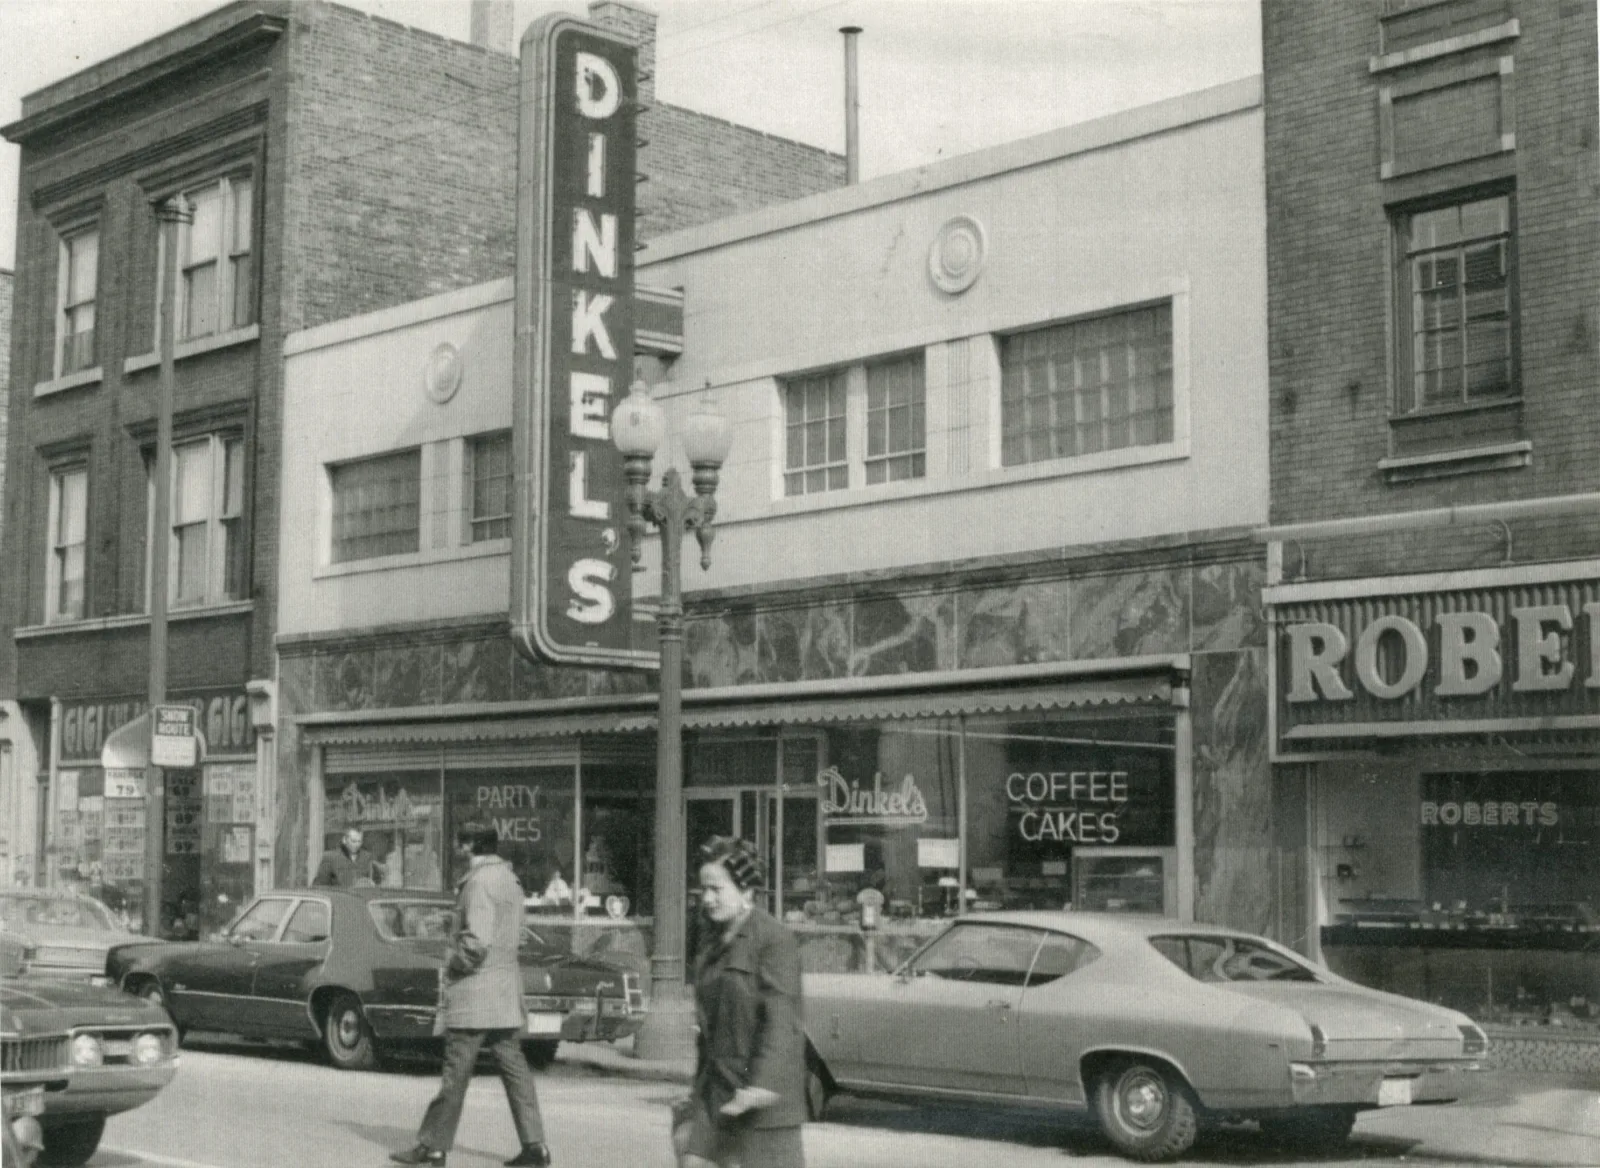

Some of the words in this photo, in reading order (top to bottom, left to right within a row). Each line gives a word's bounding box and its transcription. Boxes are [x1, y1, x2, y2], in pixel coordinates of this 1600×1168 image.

[567, 51, 623, 623] DINKEL'S
[1286, 602, 1599, 702] ROBE
[158, 722, 190, 735] ROUTE
[477, 784, 540, 809] PARTY
[1006, 771, 1129, 802] COFFEE
[1020, 811, 1121, 843] CAKES
[1420, 800, 1559, 826] ROBERTS
[490, 816, 541, 841] AKES
